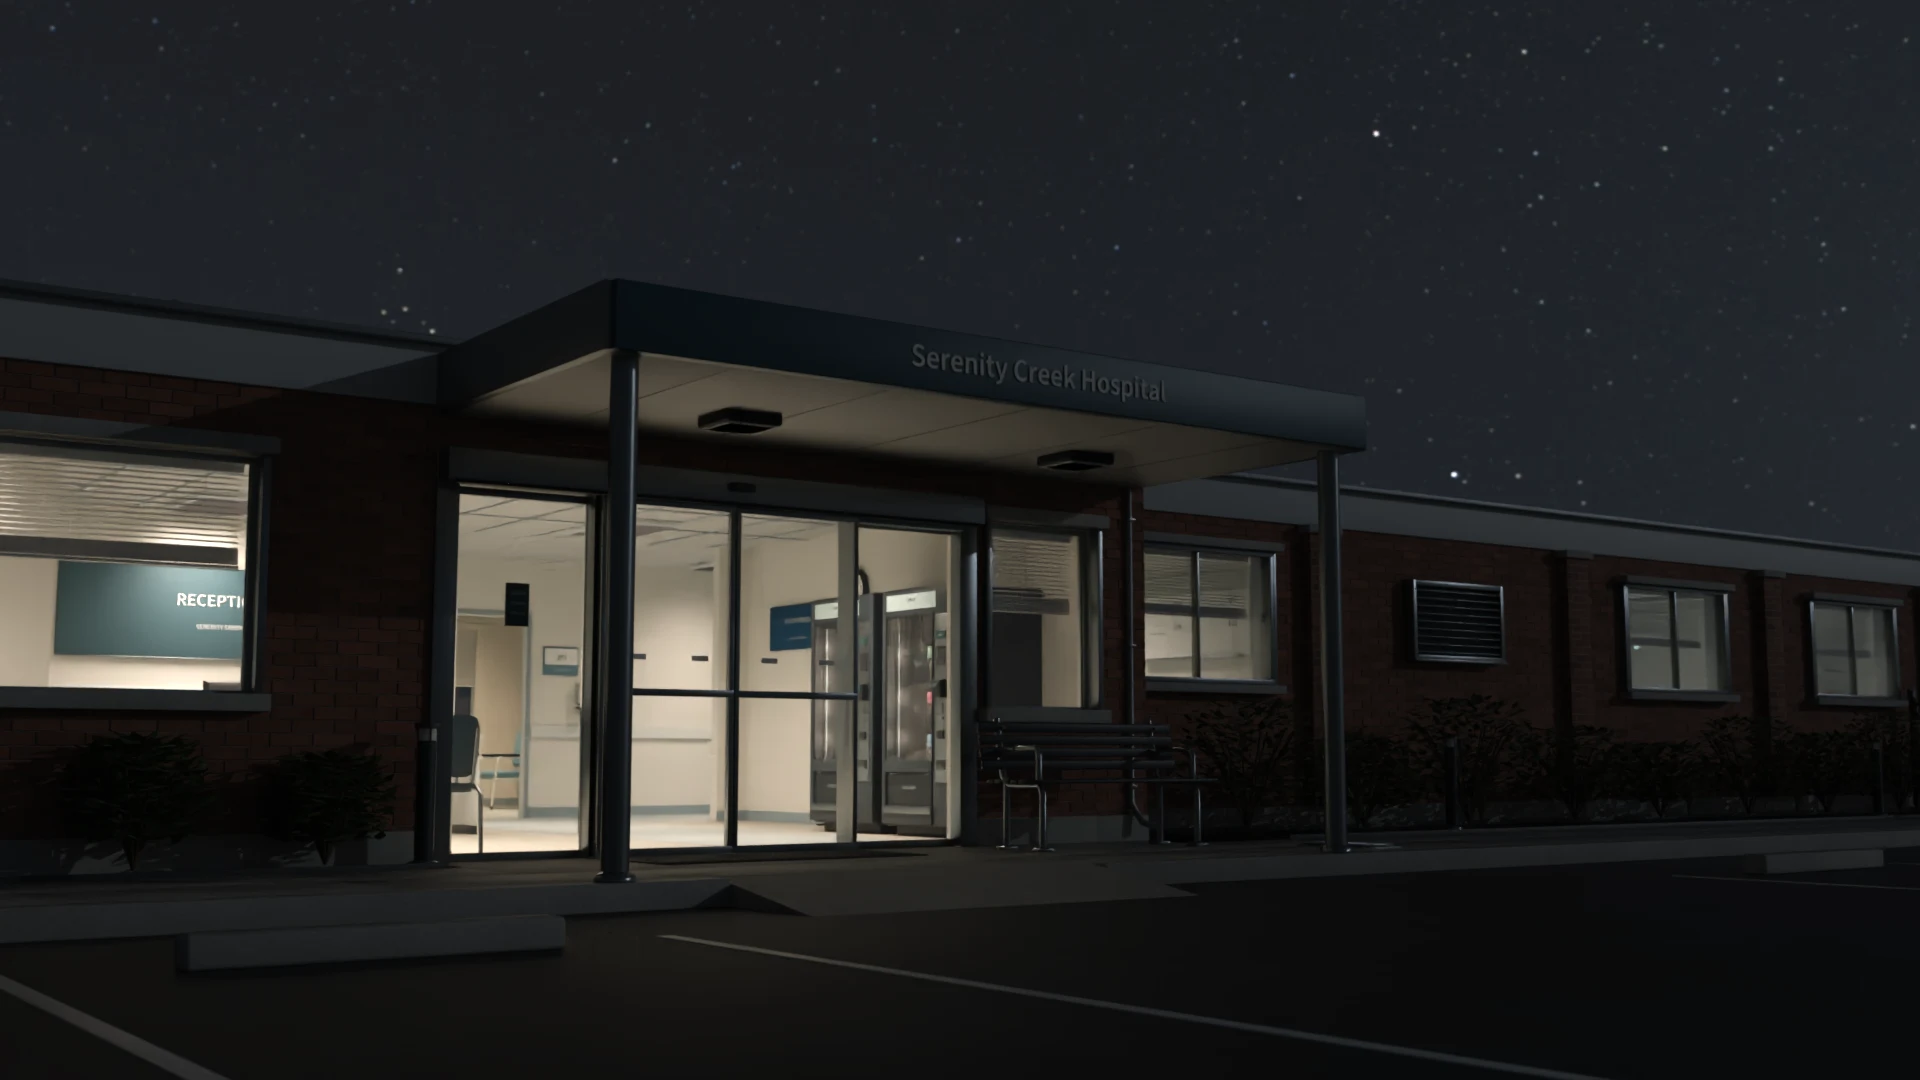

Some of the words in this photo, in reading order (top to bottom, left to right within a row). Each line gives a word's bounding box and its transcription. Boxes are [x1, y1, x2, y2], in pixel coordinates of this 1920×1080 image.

[912, 343, 1008, 384] Serenity
[1013, 359, 1076, 390] Creek
[1081, 369, 1167, 402] Hospital
